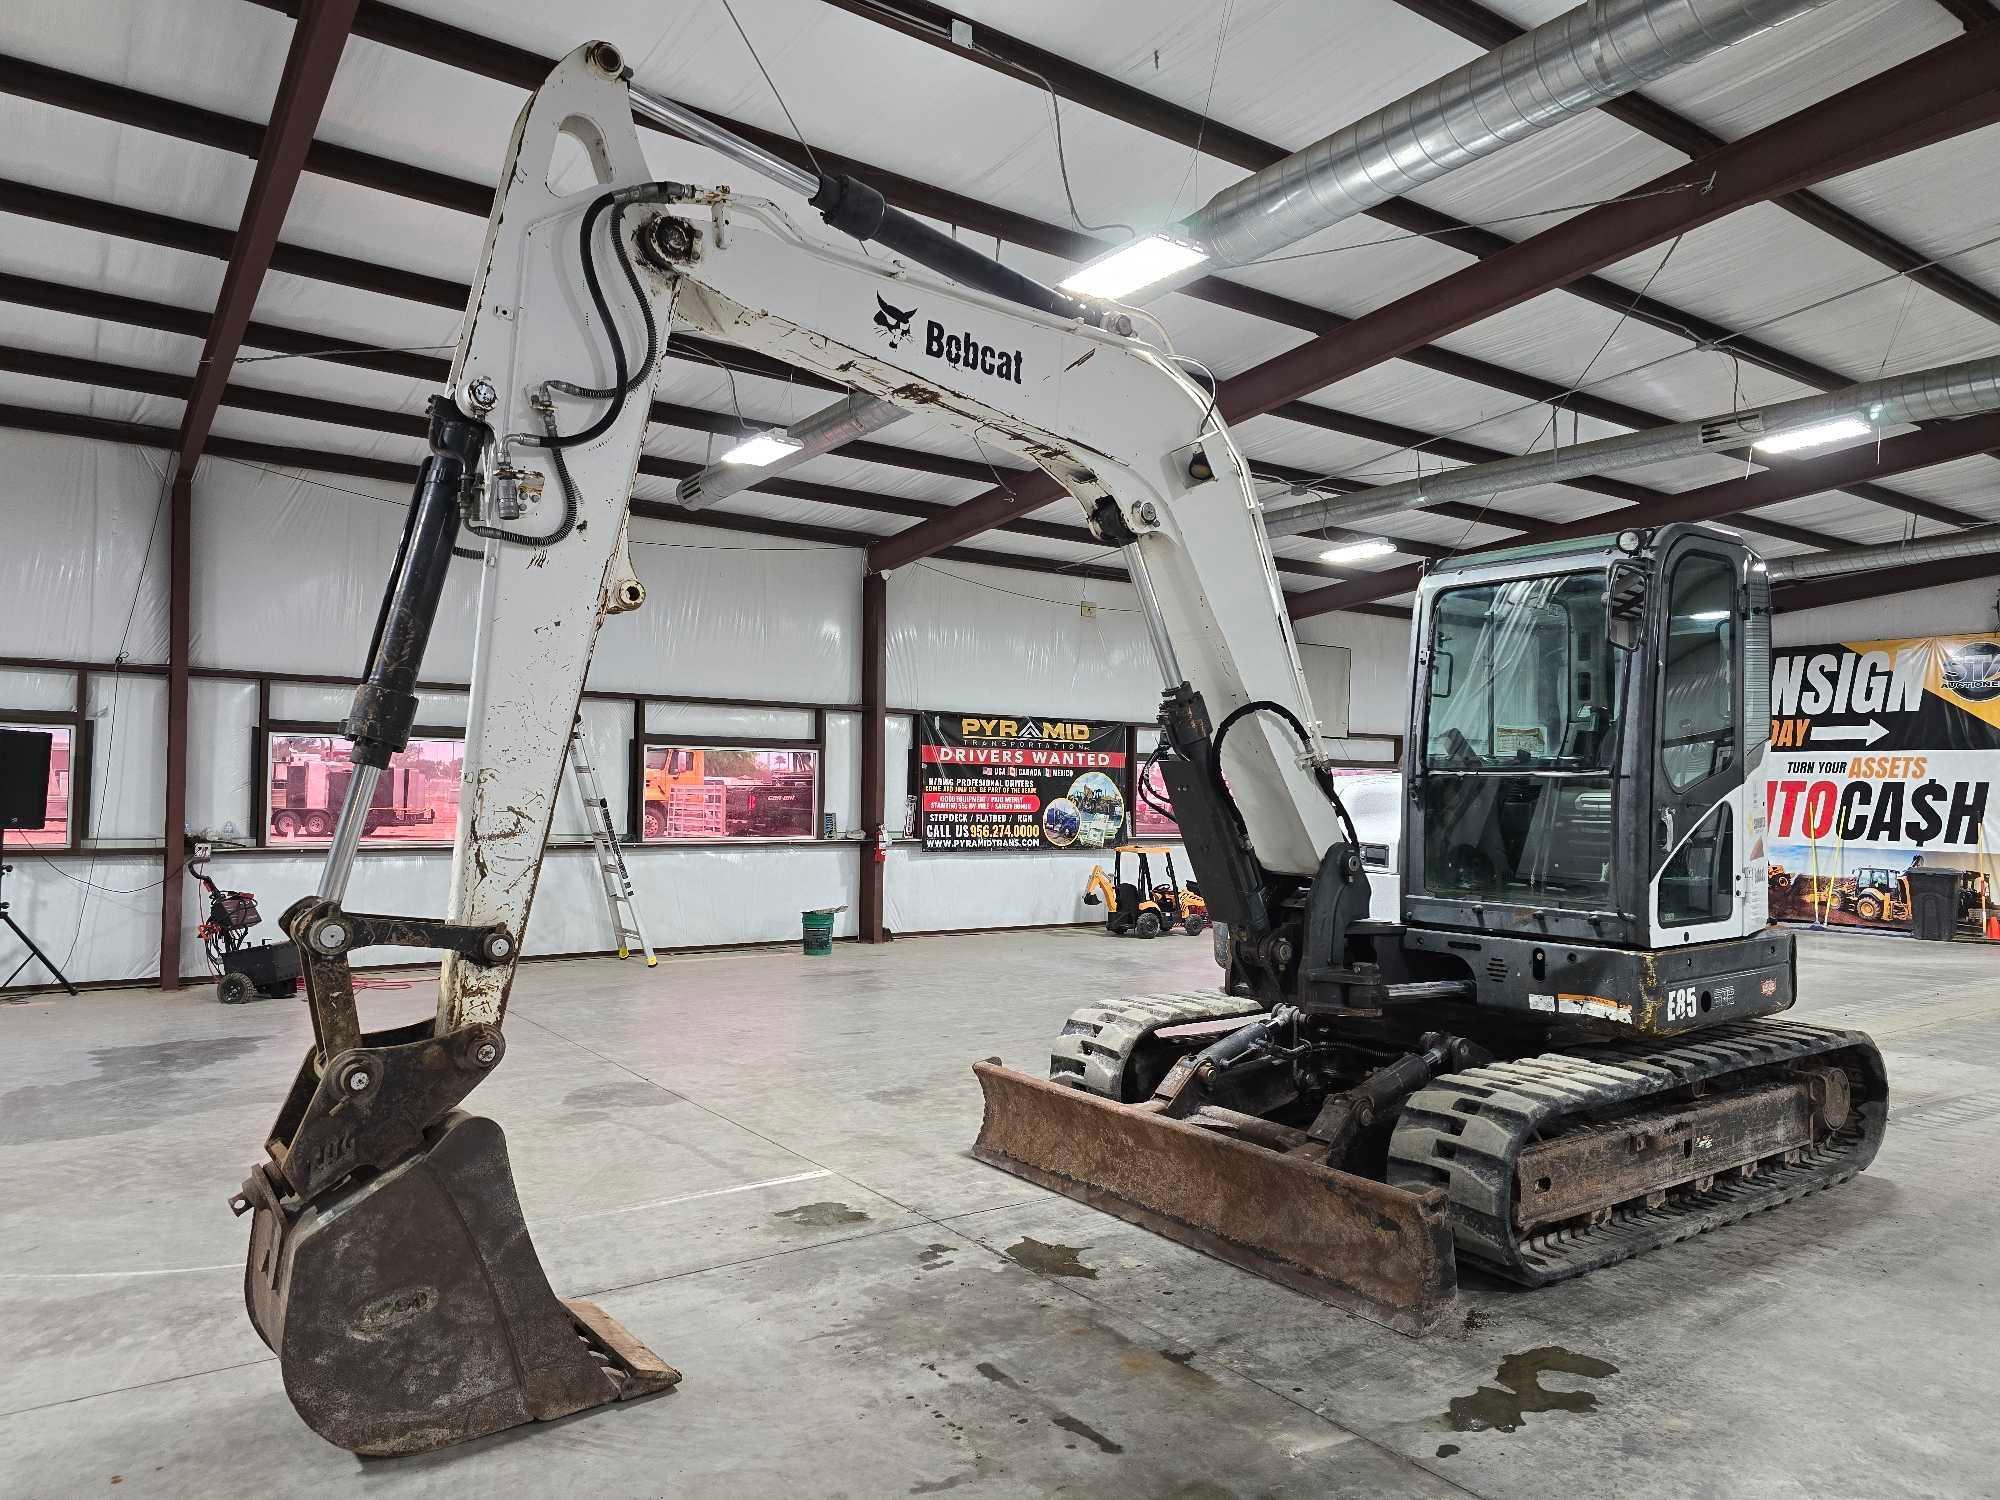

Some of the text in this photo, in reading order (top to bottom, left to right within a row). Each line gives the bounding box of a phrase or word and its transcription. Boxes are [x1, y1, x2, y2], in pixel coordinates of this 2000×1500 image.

[926, 320, 1022, 384] Bobcat
[962, 718, 1090, 740] PYRAMID
[963, 740, 1083, 750] TRANSPORTATION
[939, 748, 1110, 766] DRIVERS WANTED
[994, 767, 1073, 777] USA CANADA MEXICO
[1787, 756, 1928, 780] TURN YOUR ASSETS
[928, 777, 954, 786] HIRING
[1005, 780, 1034, 788] DRIVERS
[929, 813, 968, 823] STEPDECK
[976, 814, 1007, 823] FLATBED
[1017, 815, 1033, 823] RGN
[926, 824, 1040, 838] CALL US 956.274.0000
[926, 838, 1040, 848] WWW.PYRAMIDTRANS.COM
[1667, 986, 1697, 1022] E85
